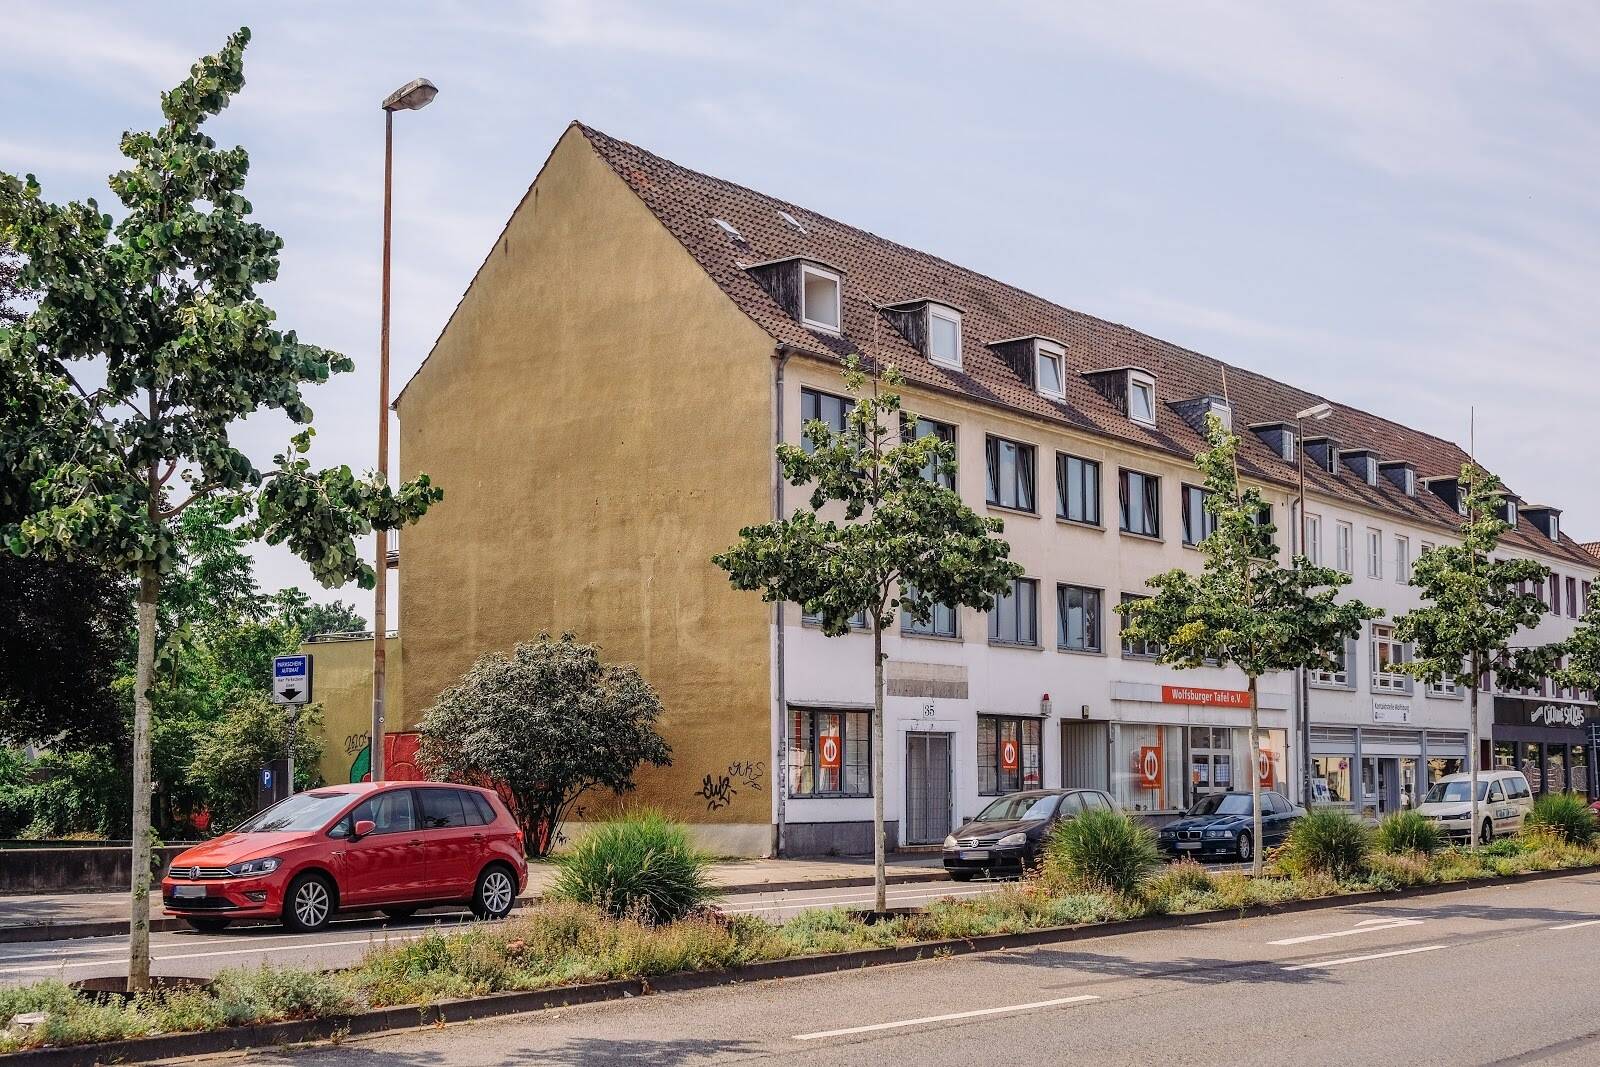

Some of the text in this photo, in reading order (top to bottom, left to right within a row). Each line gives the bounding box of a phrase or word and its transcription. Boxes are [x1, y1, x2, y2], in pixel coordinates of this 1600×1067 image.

[1171, 688, 1243, 704] Wolfsburger Tafel e.V.
[924, 704, 935, 717] 35
[264, 771, 270, 785] P
